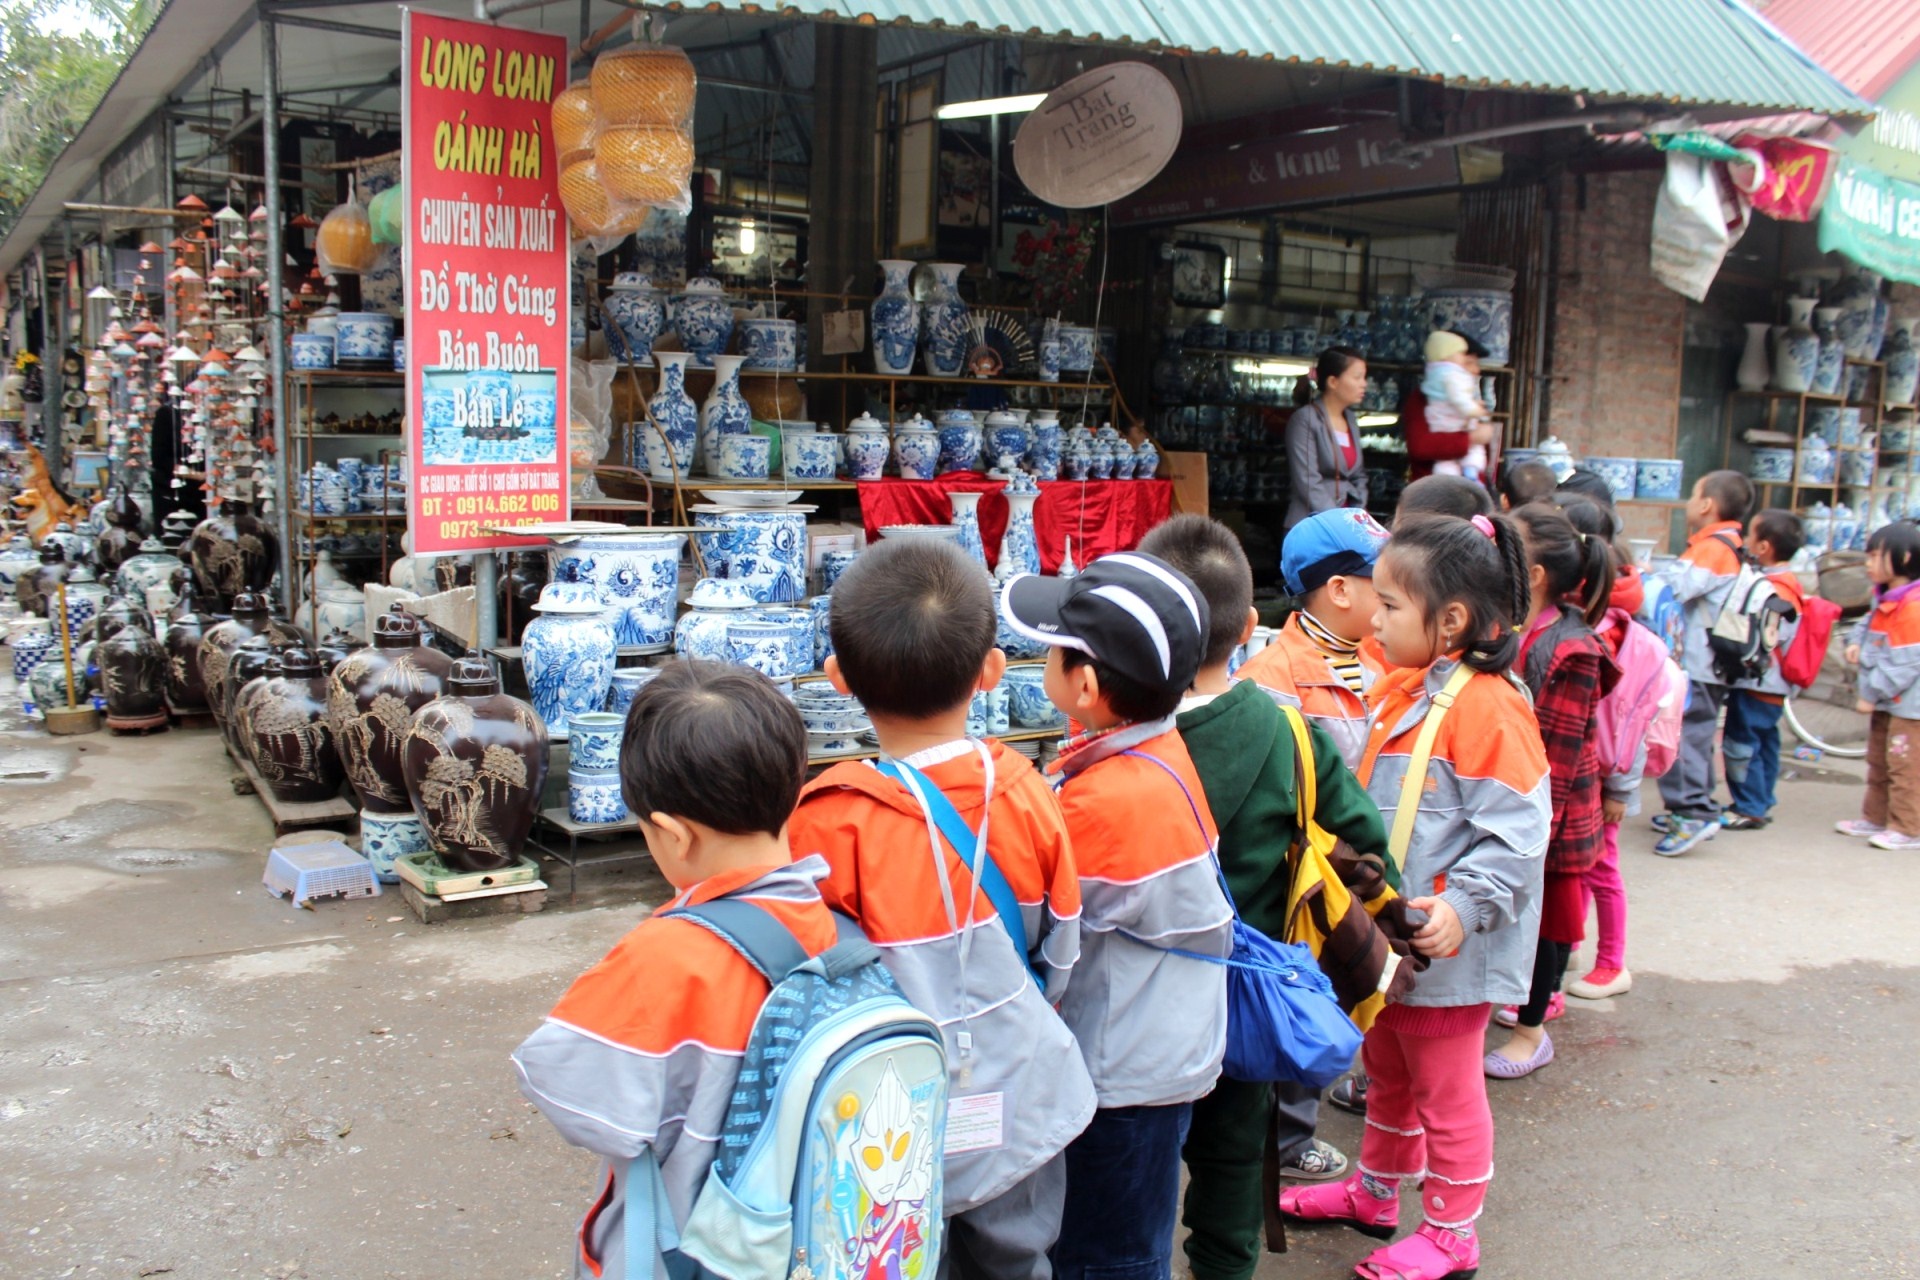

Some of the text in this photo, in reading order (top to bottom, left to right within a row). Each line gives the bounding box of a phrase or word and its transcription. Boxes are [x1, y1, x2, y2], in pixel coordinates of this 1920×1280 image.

[420, 36, 555, 103] LONG LOAN
[1053, 102, 1137, 149] Trang
[1068, 89, 1116, 124] Bat
[433, 109, 541, 180] OÁNH HÀ
[1248, 157, 1268, 184] &
[420, 185, 556, 253] CHUYÊN SẢN XUẤT
[420, 261, 557, 327] Đồ Thờ Cúng
[438, 330, 540, 373] Bán Buôn
[453, 384, 525, 428] Bán Lẻ
[456, 494, 528, 515] 0914.662
[531, 493, 559, 512] 006
